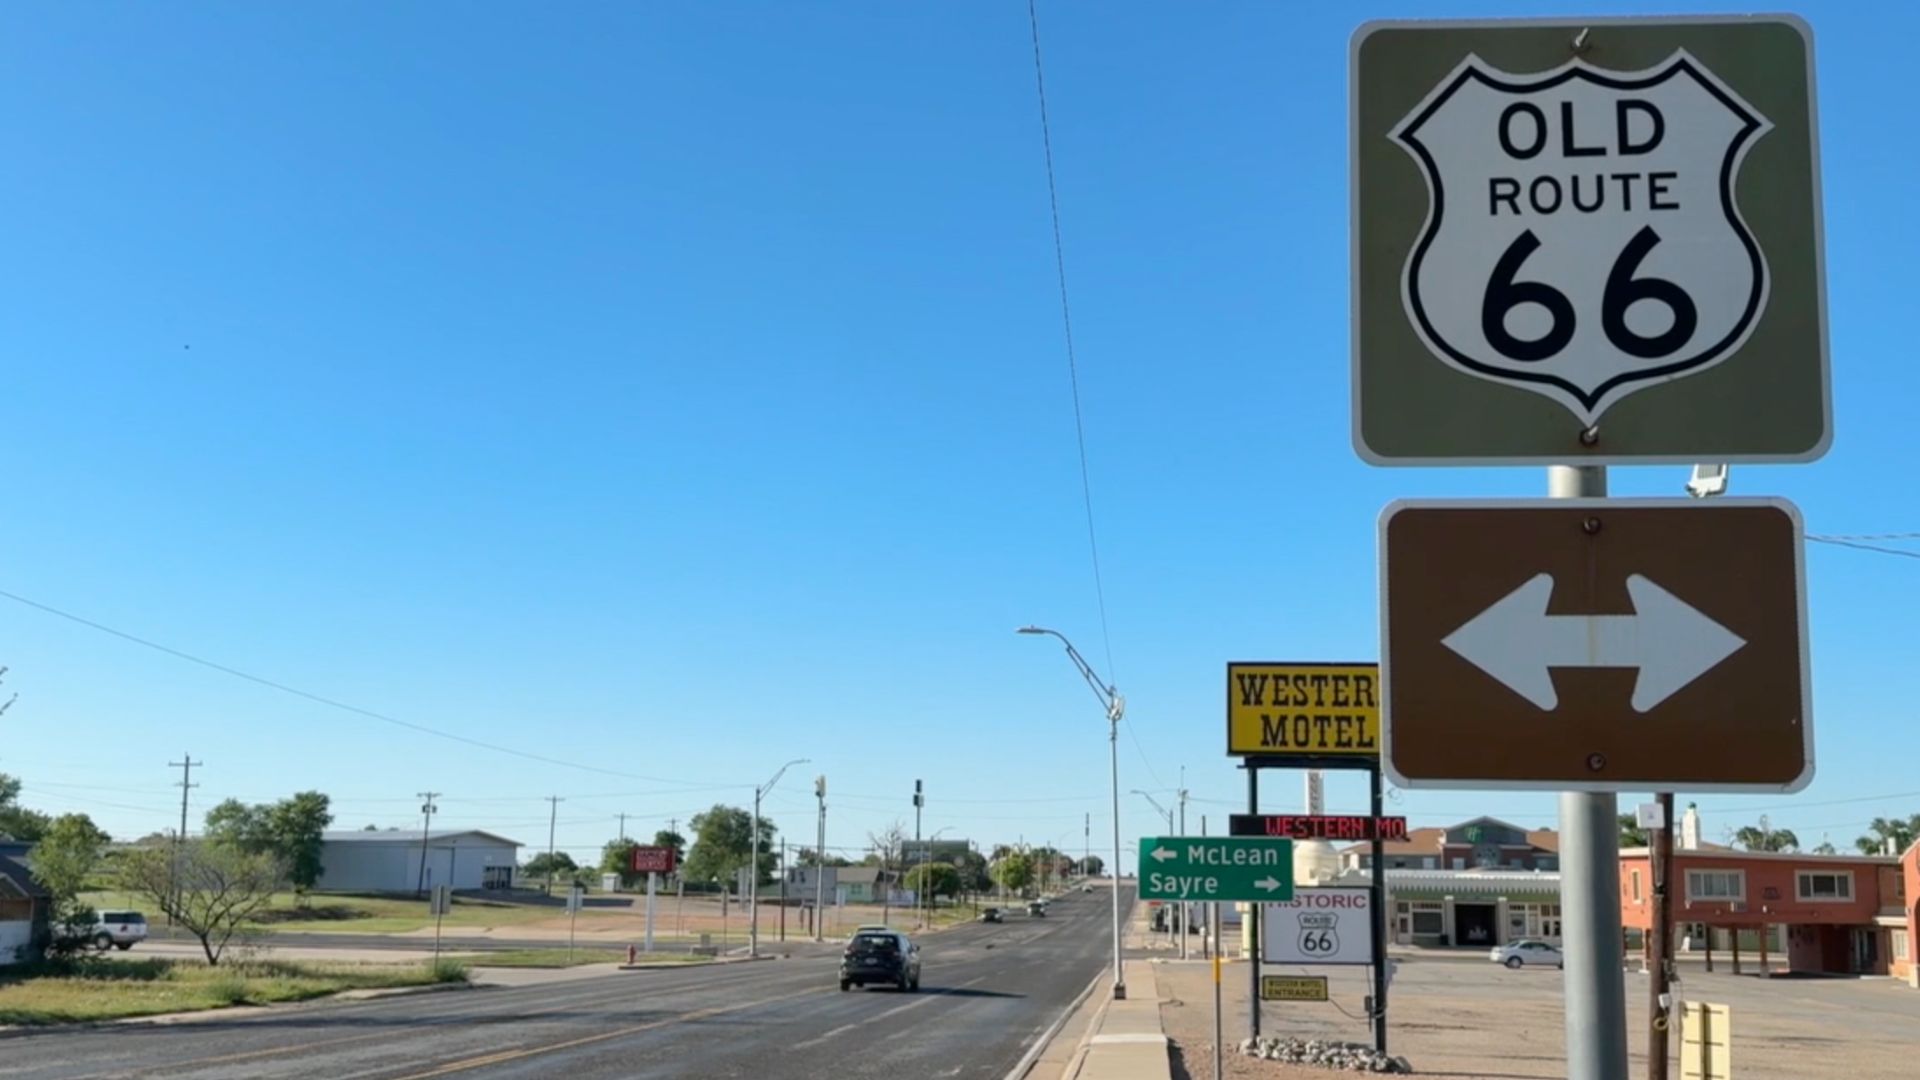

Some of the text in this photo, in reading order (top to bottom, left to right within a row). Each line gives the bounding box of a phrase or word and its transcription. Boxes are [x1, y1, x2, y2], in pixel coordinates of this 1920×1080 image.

[1498, 98, 1665, 160] OLD
[1490, 172, 1680, 216] ROUTE
[1481, 225, 1698, 362] 66
[1236, 673, 1380, 708] WESTER
[1260, 714, 1375, 748] MOTEL
[1265, 817, 1364, 838] WESTERN
[1188, 845, 1278, 866] McLean
[1149, 873, 1219, 898] Sayre
[1303, 916, 1334, 924] ROUTE
[1304, 931, 1332, 952] 66
[1268, 988, 1321, 997] ENTRANCE
